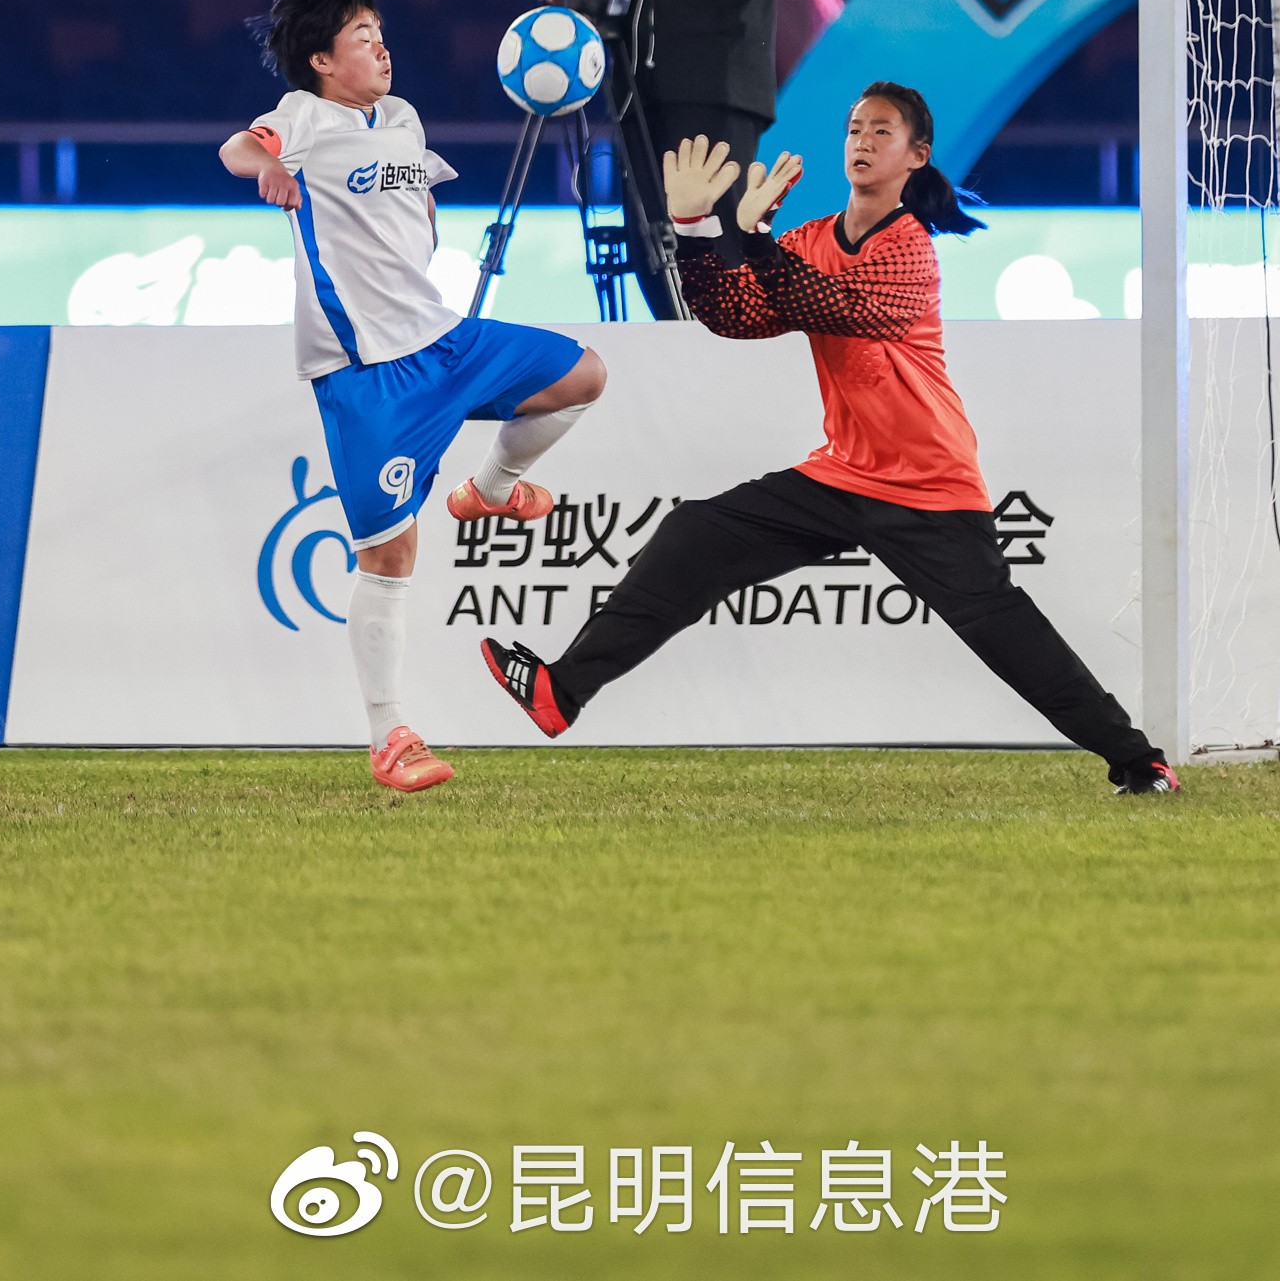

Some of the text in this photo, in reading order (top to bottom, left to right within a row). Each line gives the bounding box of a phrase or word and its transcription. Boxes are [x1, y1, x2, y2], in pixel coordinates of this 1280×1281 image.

[378, 455, 417, 510] 9
[446, 584, 931, 625] ANT FNDATIO
